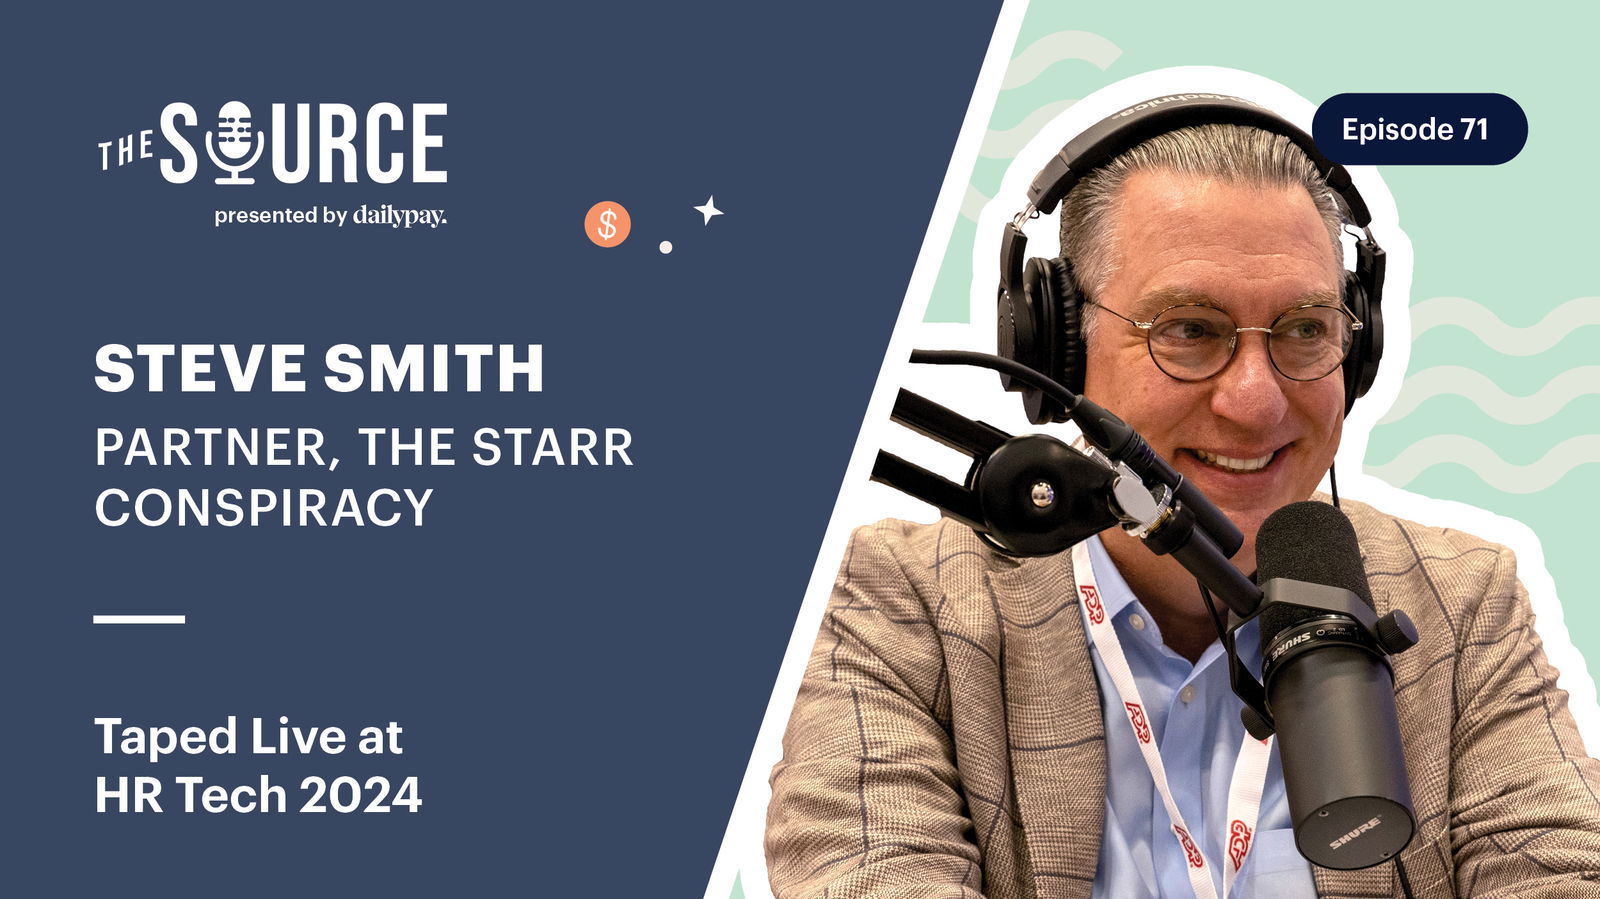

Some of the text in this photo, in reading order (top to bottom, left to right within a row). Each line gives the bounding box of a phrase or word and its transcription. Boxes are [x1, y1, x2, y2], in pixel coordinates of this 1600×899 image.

[1080, 585, 1105, 625] ADP
[1272, 631, 1312, 662] SHURE
[1124, 702, 1152, 745] ADP
[1228, 819, 1252, 872] ADP
[1329, 817, 1382, 850] SHURE
